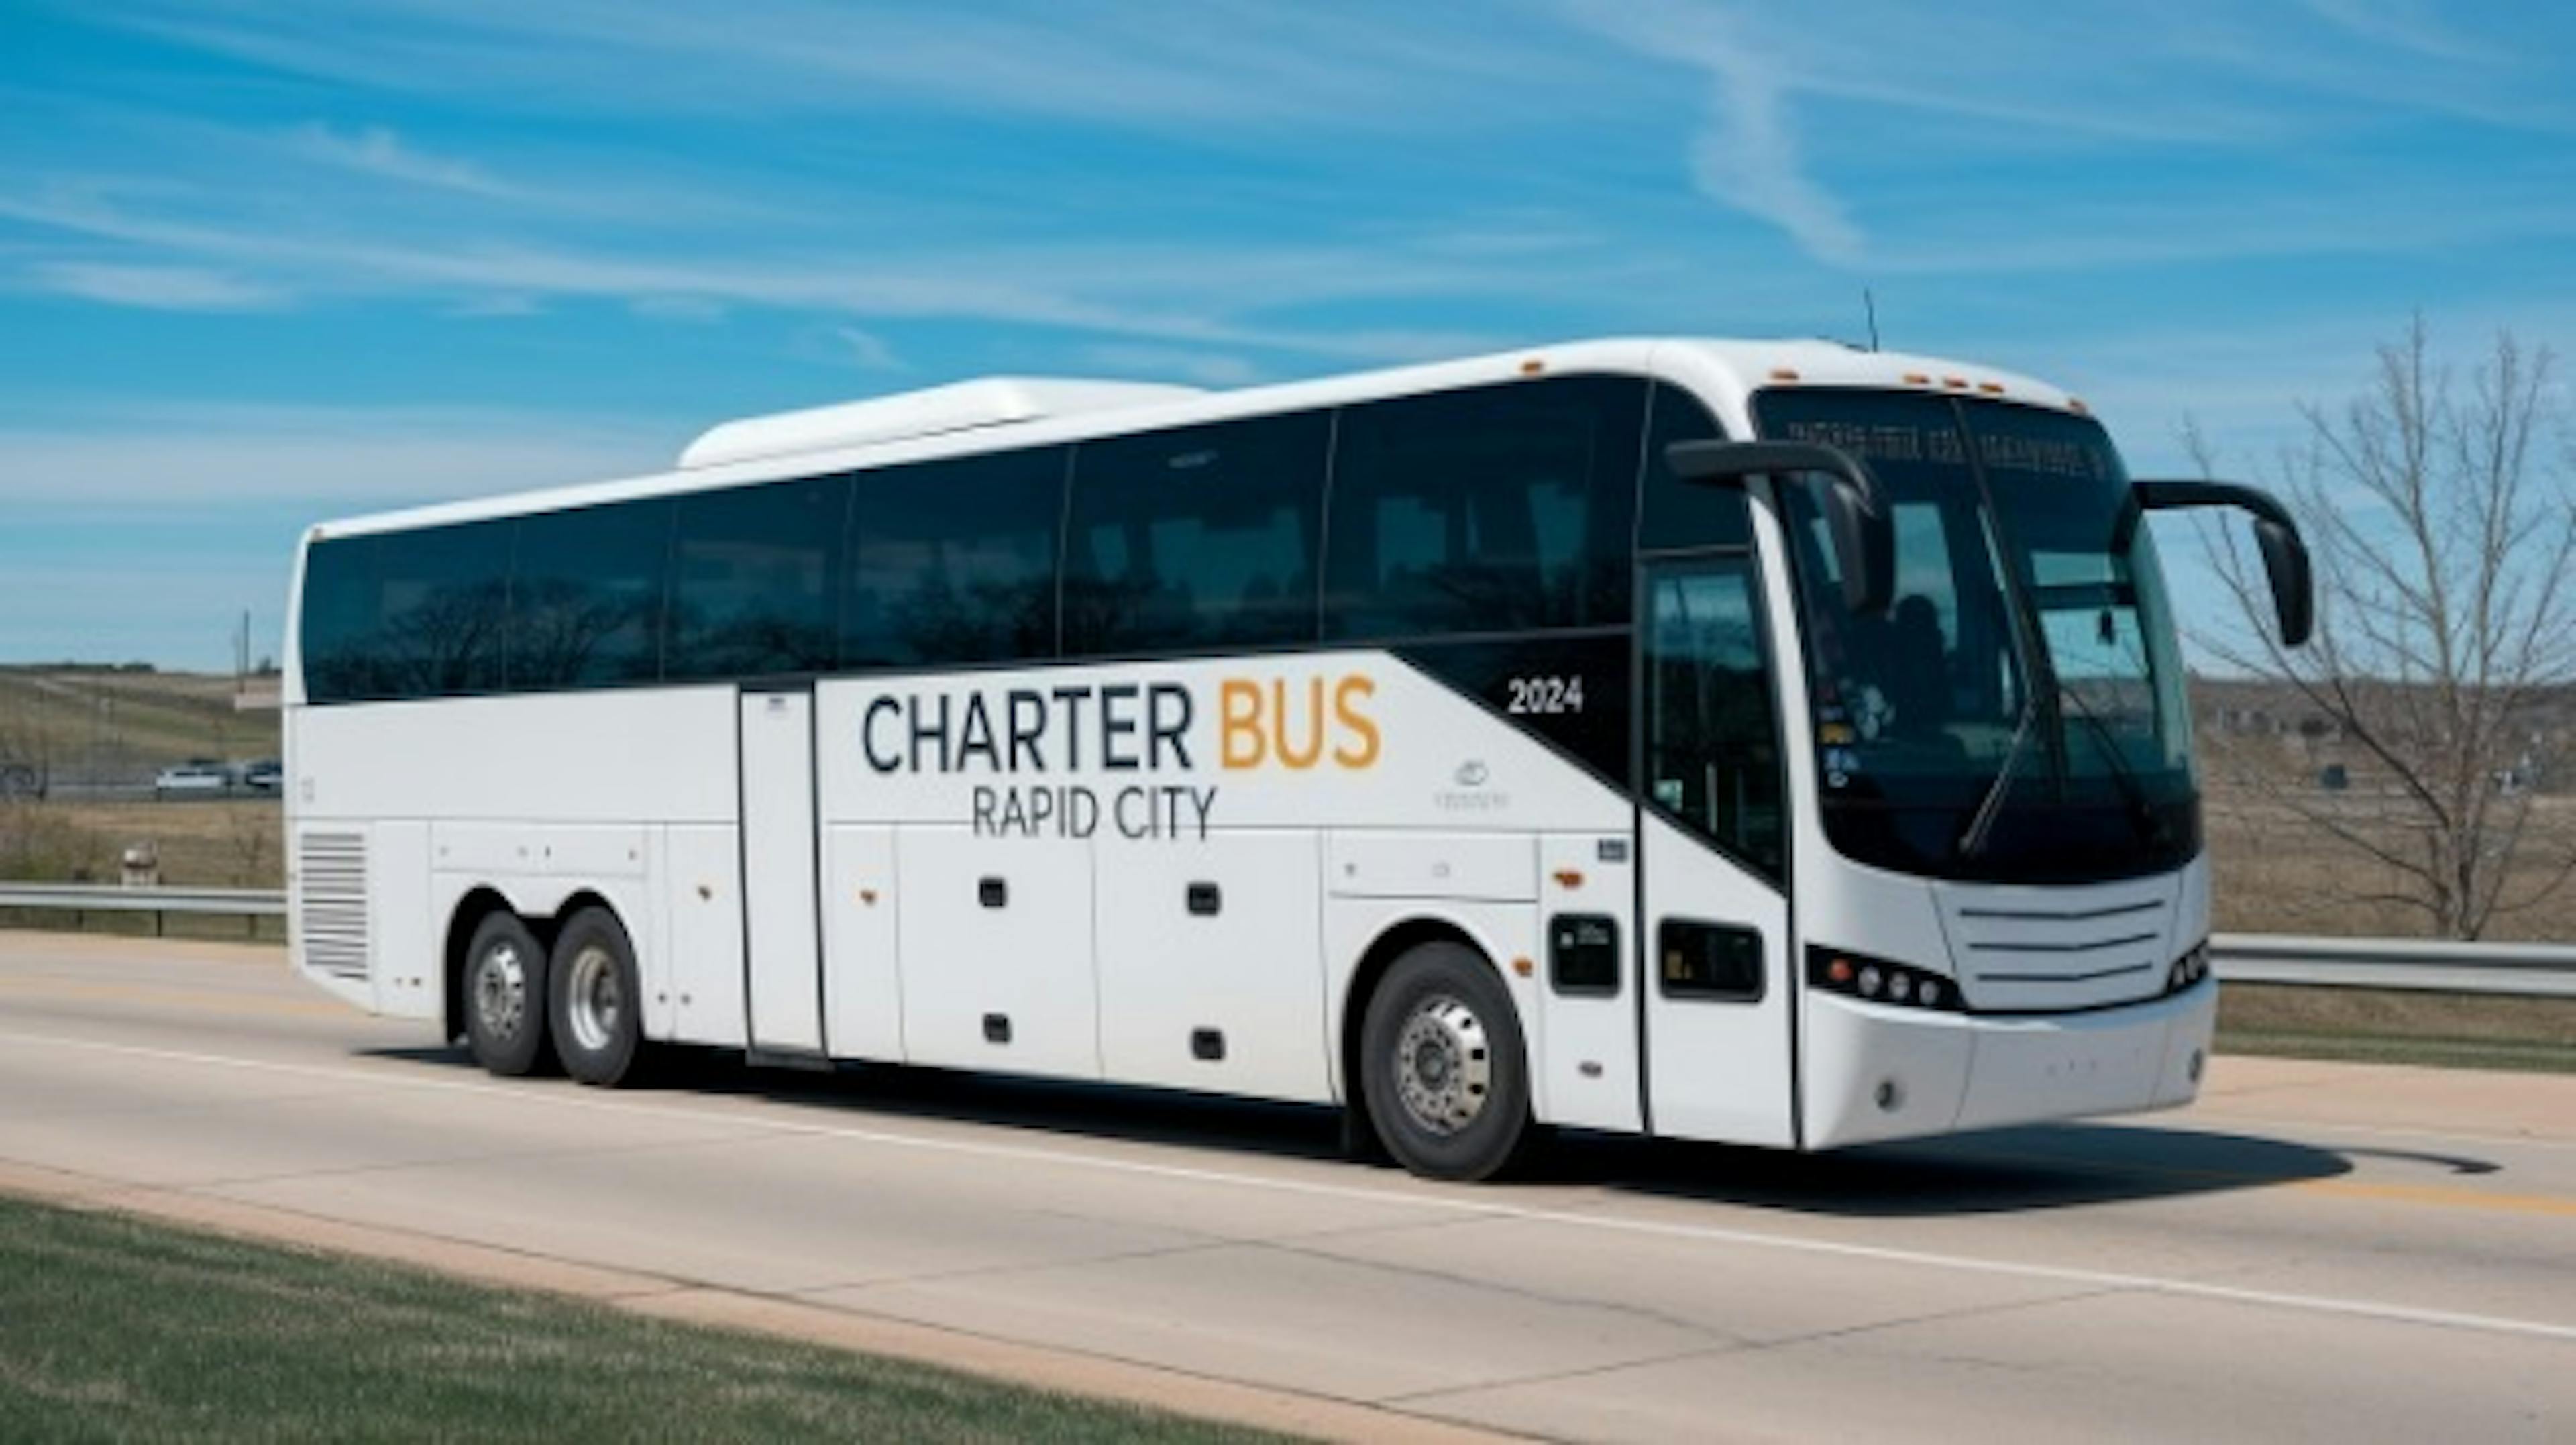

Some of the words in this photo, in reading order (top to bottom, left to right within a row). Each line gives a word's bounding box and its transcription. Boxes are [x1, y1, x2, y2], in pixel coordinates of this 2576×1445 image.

[1508, 675, 1583, 714] 2024
[861, 683, 1195, 774] CHARTER
[1218, 674, 1381, 771] BUS
[973, 785, 1098, 839] RAPID
[1114, 786, 1216, 840] CITY
